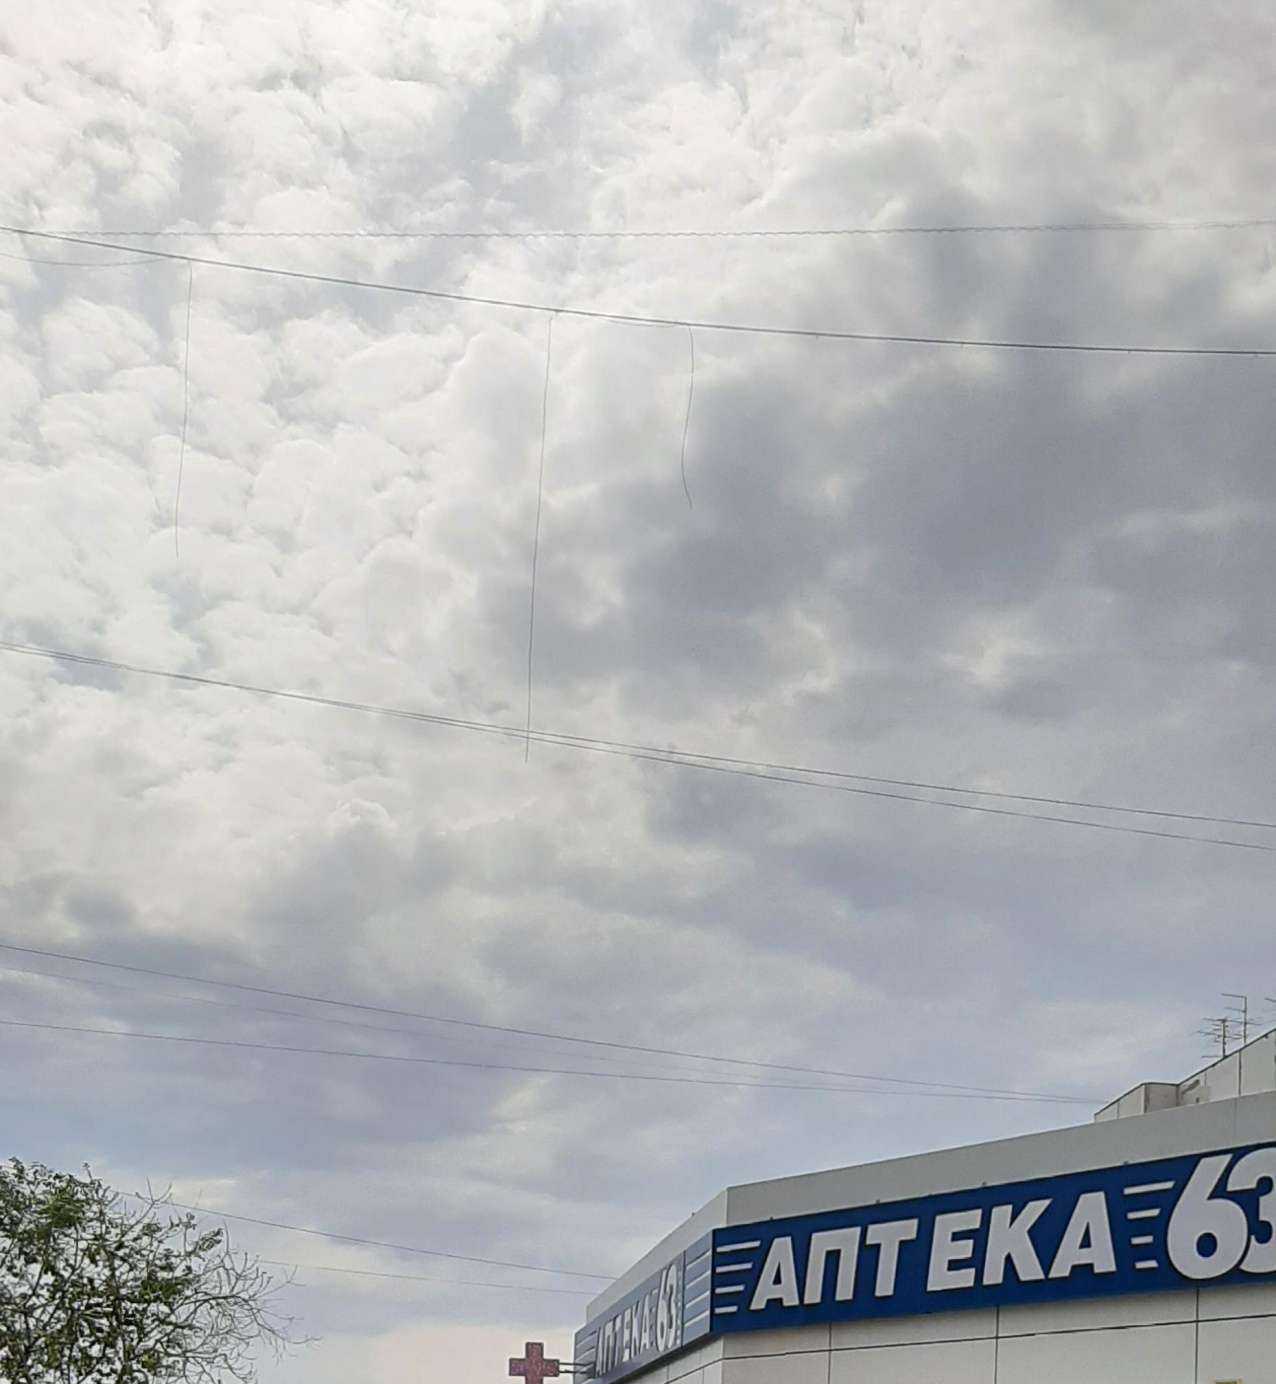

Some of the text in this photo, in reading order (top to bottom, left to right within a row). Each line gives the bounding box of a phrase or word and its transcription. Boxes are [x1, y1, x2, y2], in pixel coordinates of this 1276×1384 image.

[750, 1147, 1276, 1311] АПТЕКА 63
[595, 1264, 678, 1377] АПТЕКА 63
